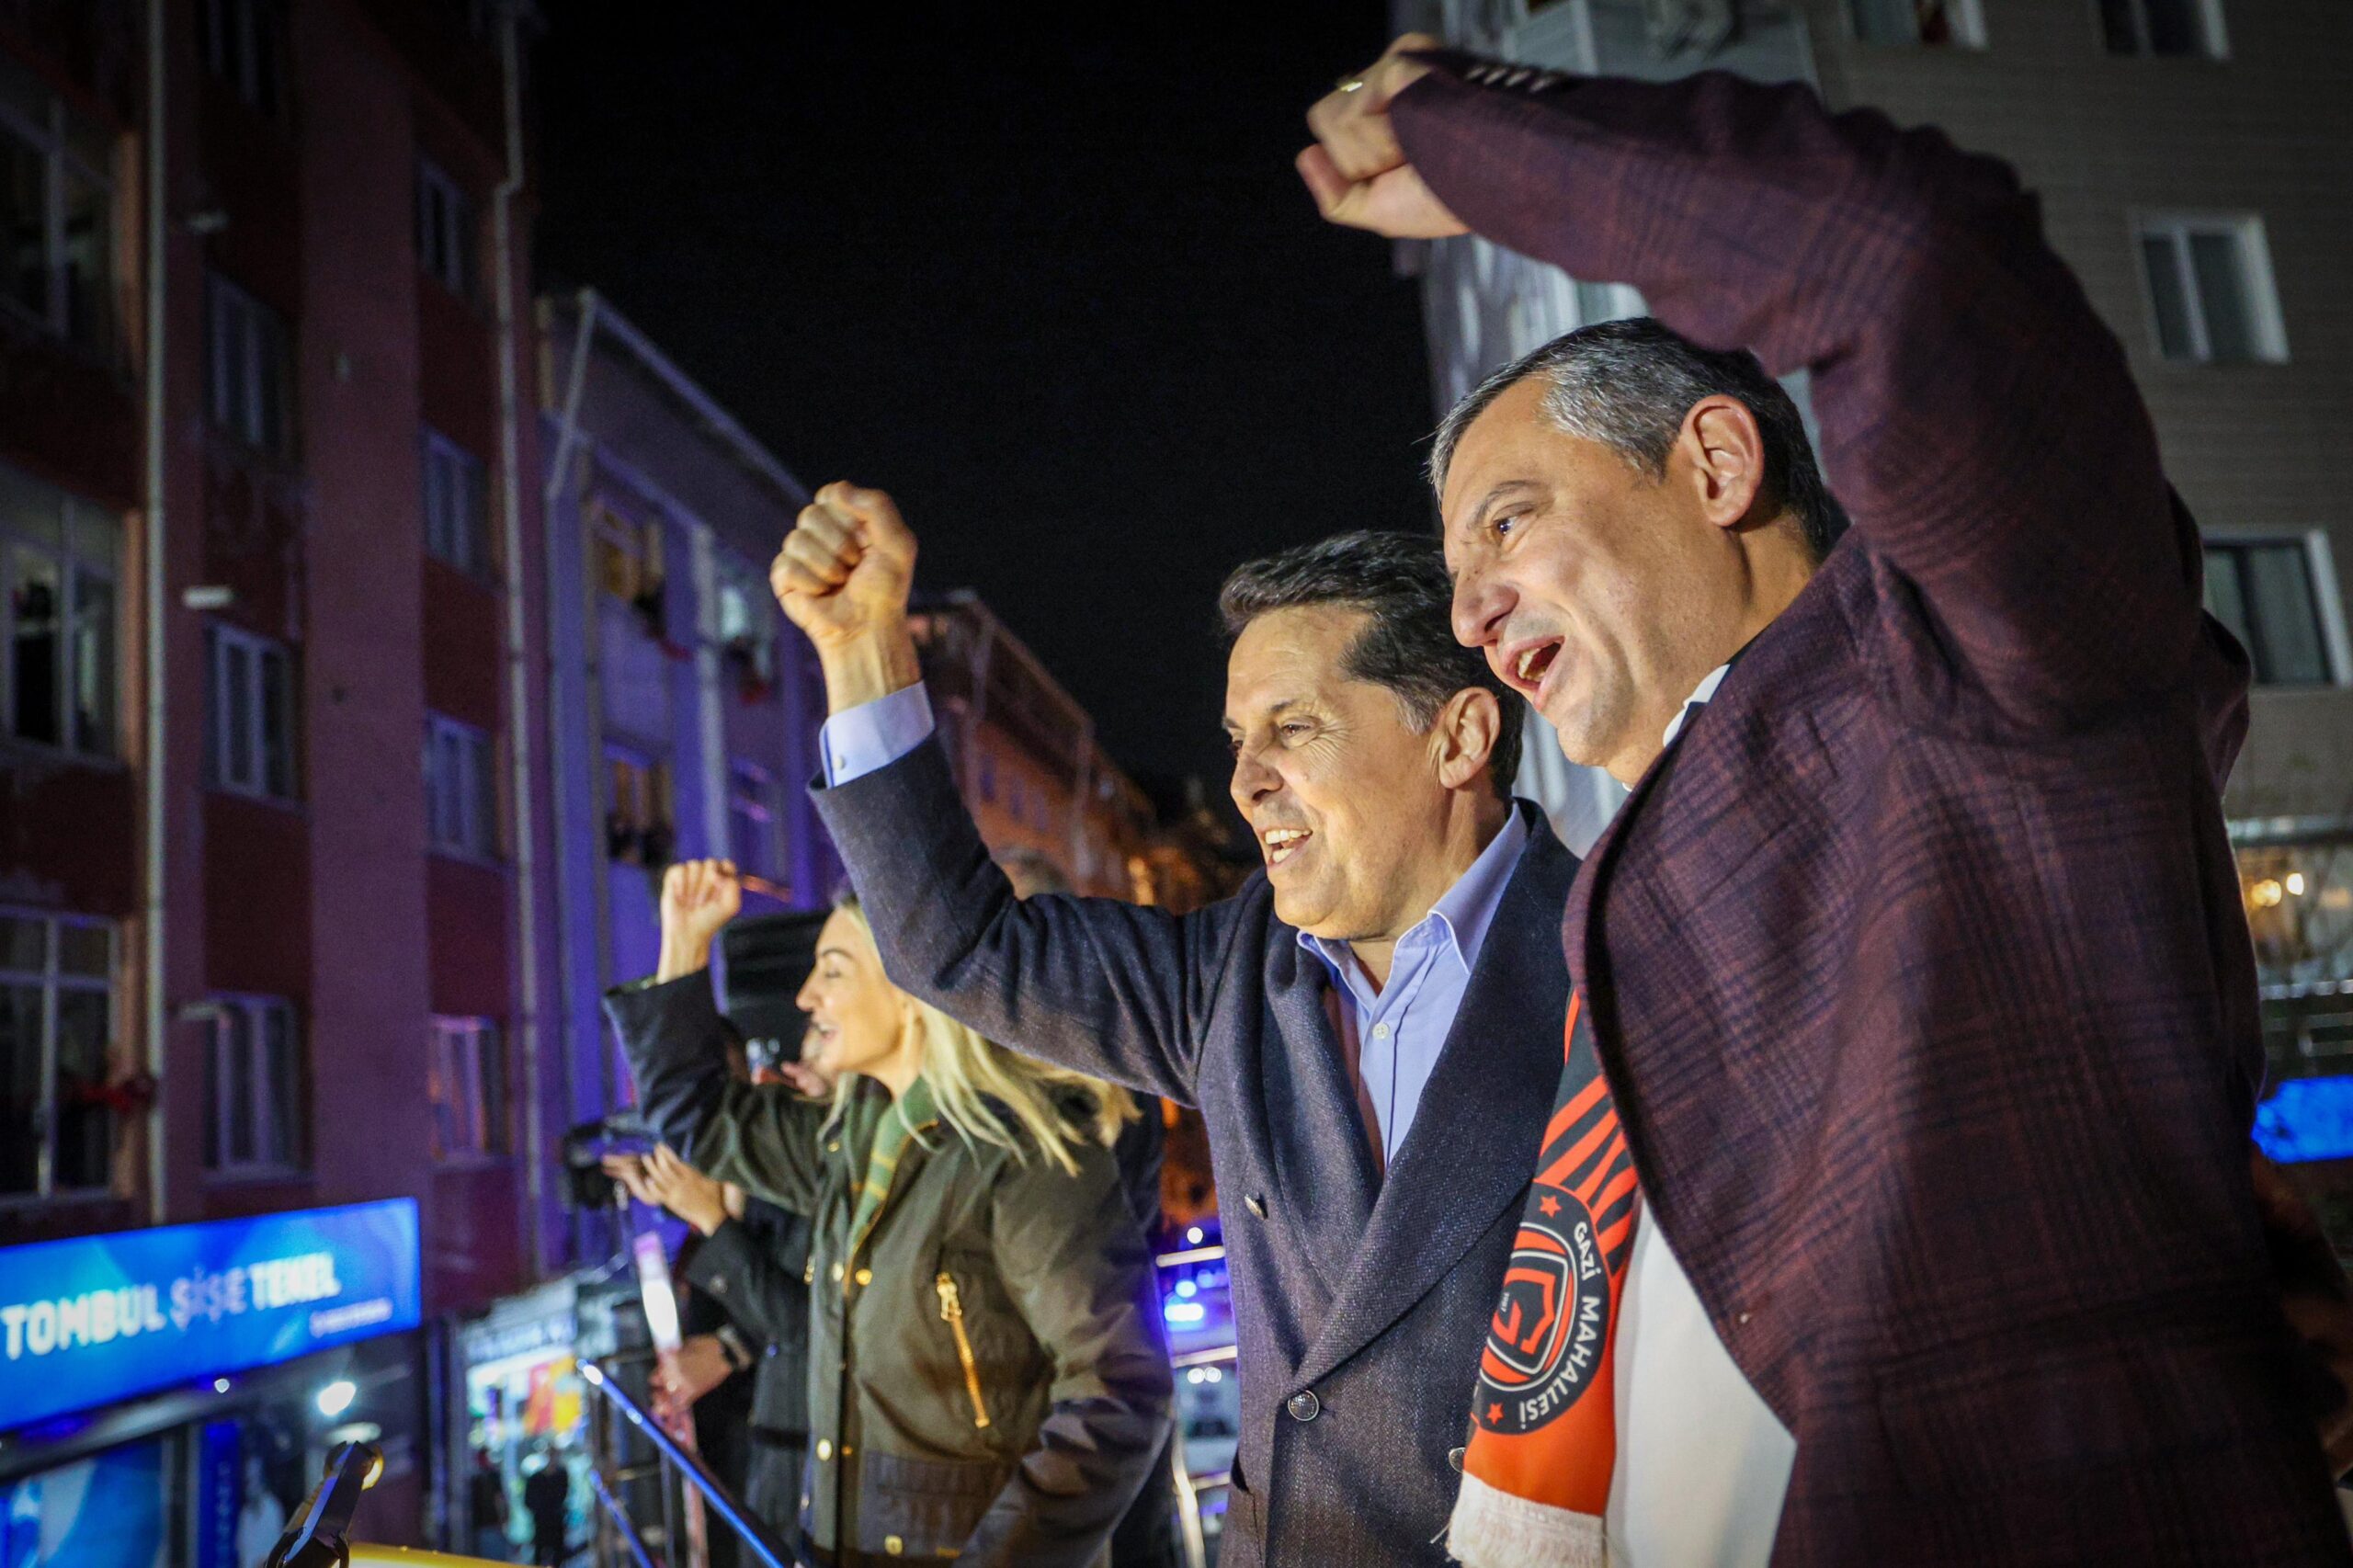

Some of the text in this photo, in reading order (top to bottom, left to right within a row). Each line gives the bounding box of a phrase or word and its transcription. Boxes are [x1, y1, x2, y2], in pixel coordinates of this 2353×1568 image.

[1, 1284, 166, 1360] TOMBUL
[1519, 1221, 1601, 1429] GAZİ MAHALLESİ
